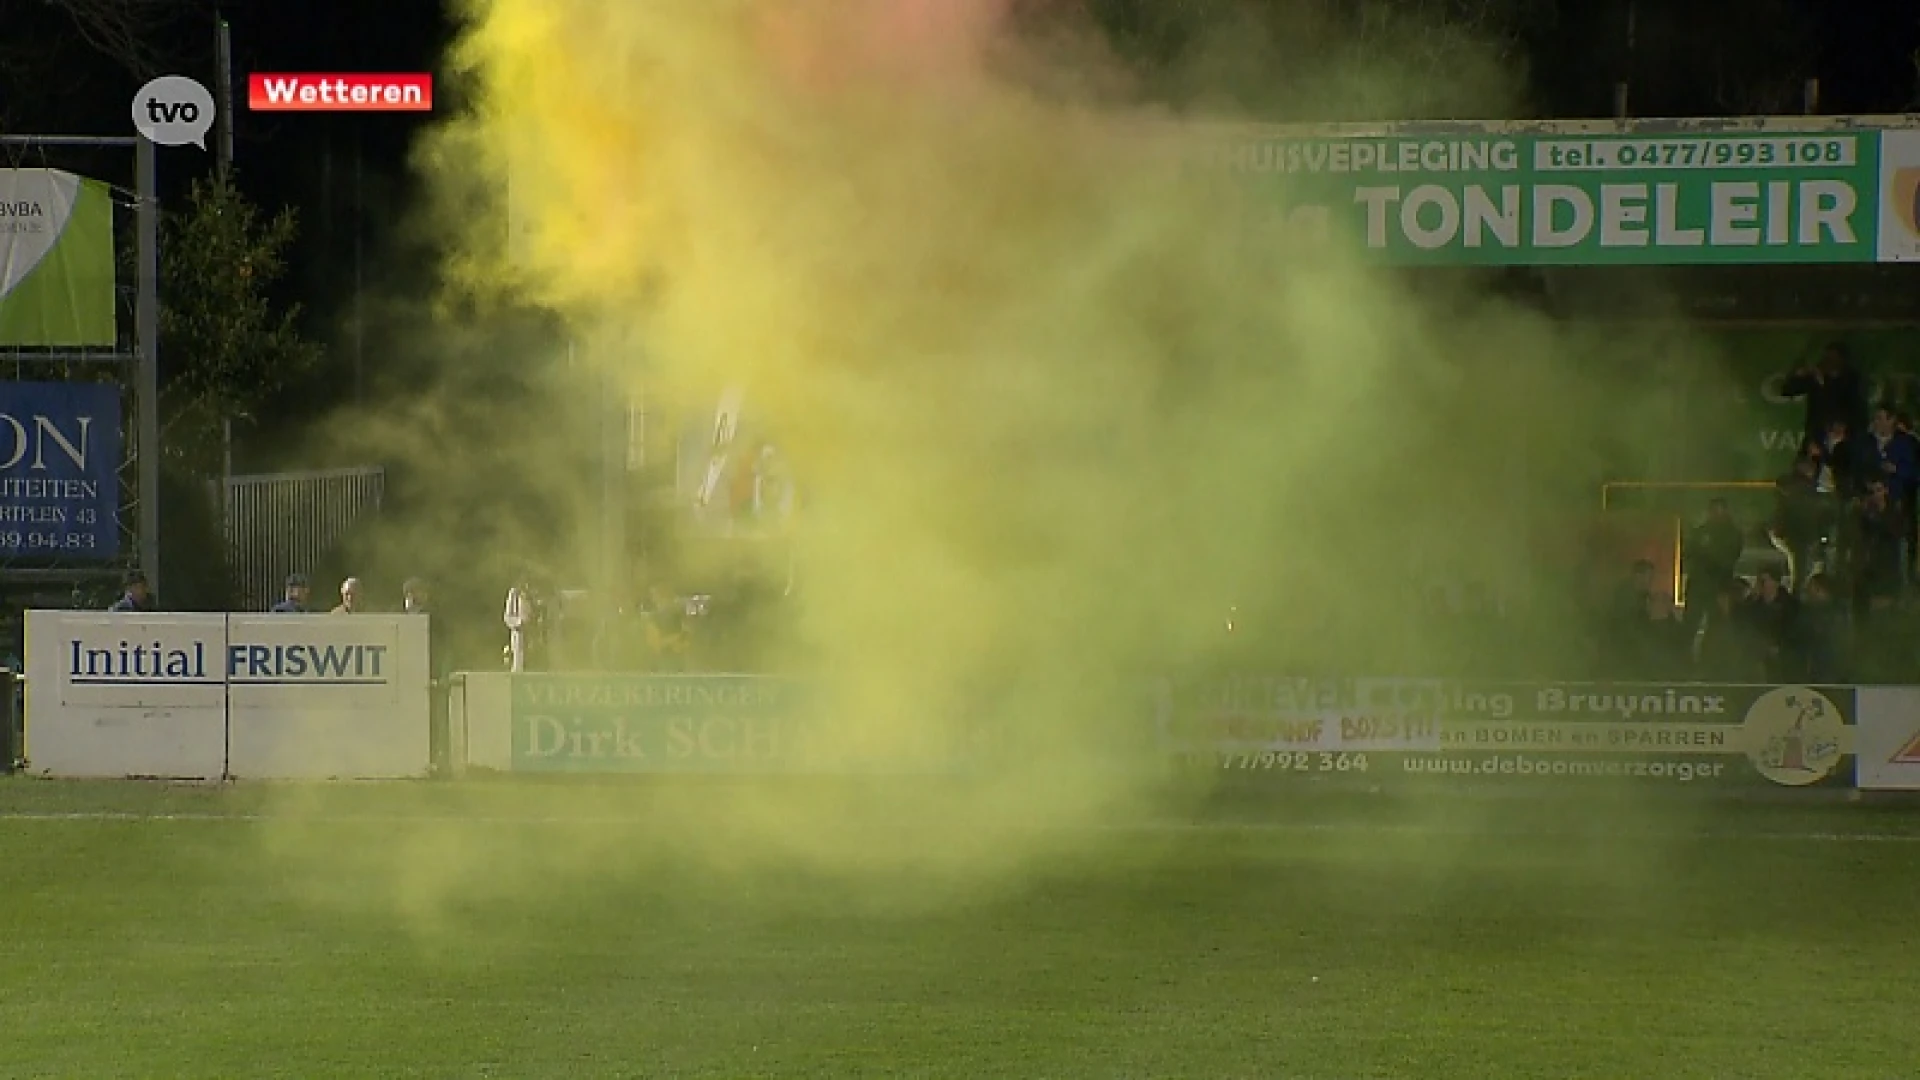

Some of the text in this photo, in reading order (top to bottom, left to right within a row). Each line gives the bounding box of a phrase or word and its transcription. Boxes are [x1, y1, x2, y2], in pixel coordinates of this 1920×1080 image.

[1550, 143, 1605, 167] tel.
[1616, 141, 1775, 166] 0477/993
[1785, 141, 1842, 163] 108
[1353, 179, 1858, 249] TONDELEIR
[0, 478, 97, 498] ITEITEN
[69, 640, 387, 678] Initial FRISWIT
[1536, 687, 1725, 719] Bruyninx
[523, 713, 646, 758] Dirk
[1475, 729, 1562, 744] BOMEN
[1570, 733, 1599, 744] en
[1607, 731, 1725, 746] SPARREN
[1318, 751, 1369, 773] 364
